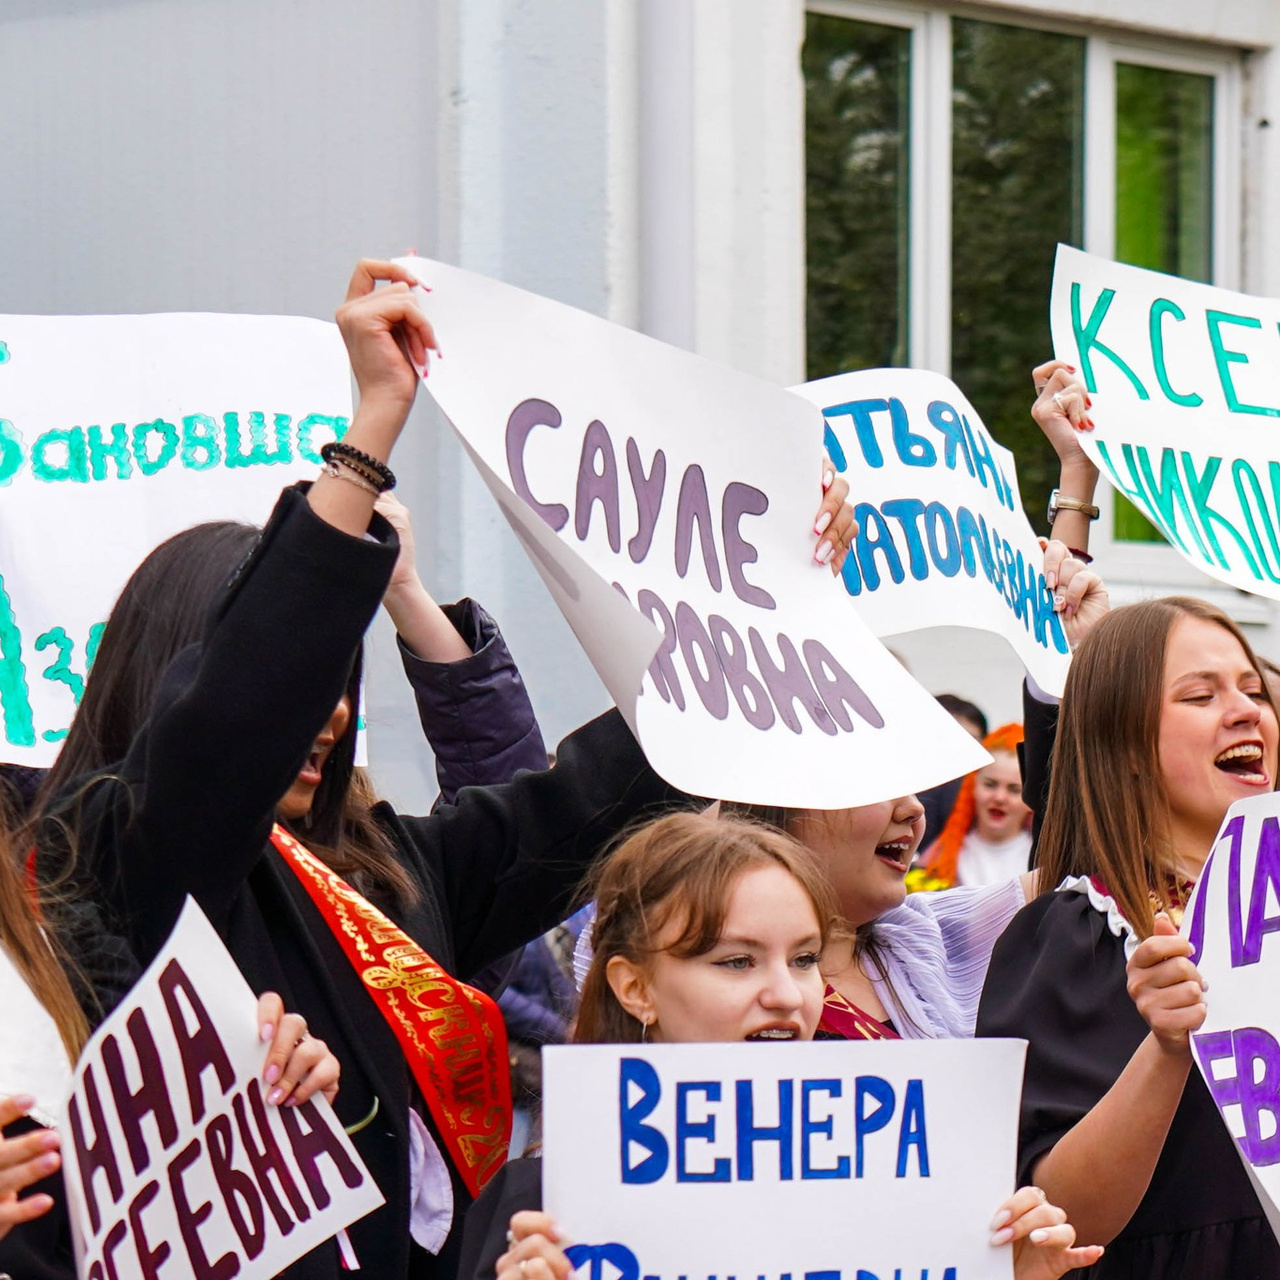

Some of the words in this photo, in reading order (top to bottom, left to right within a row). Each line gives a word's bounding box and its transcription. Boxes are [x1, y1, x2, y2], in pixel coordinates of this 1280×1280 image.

[505, 397, 777, 611] САУЛЕ
[610, 580, 885, 737] РОВНА
[619, 1057, 931, 1185] ВЕНЕРА
